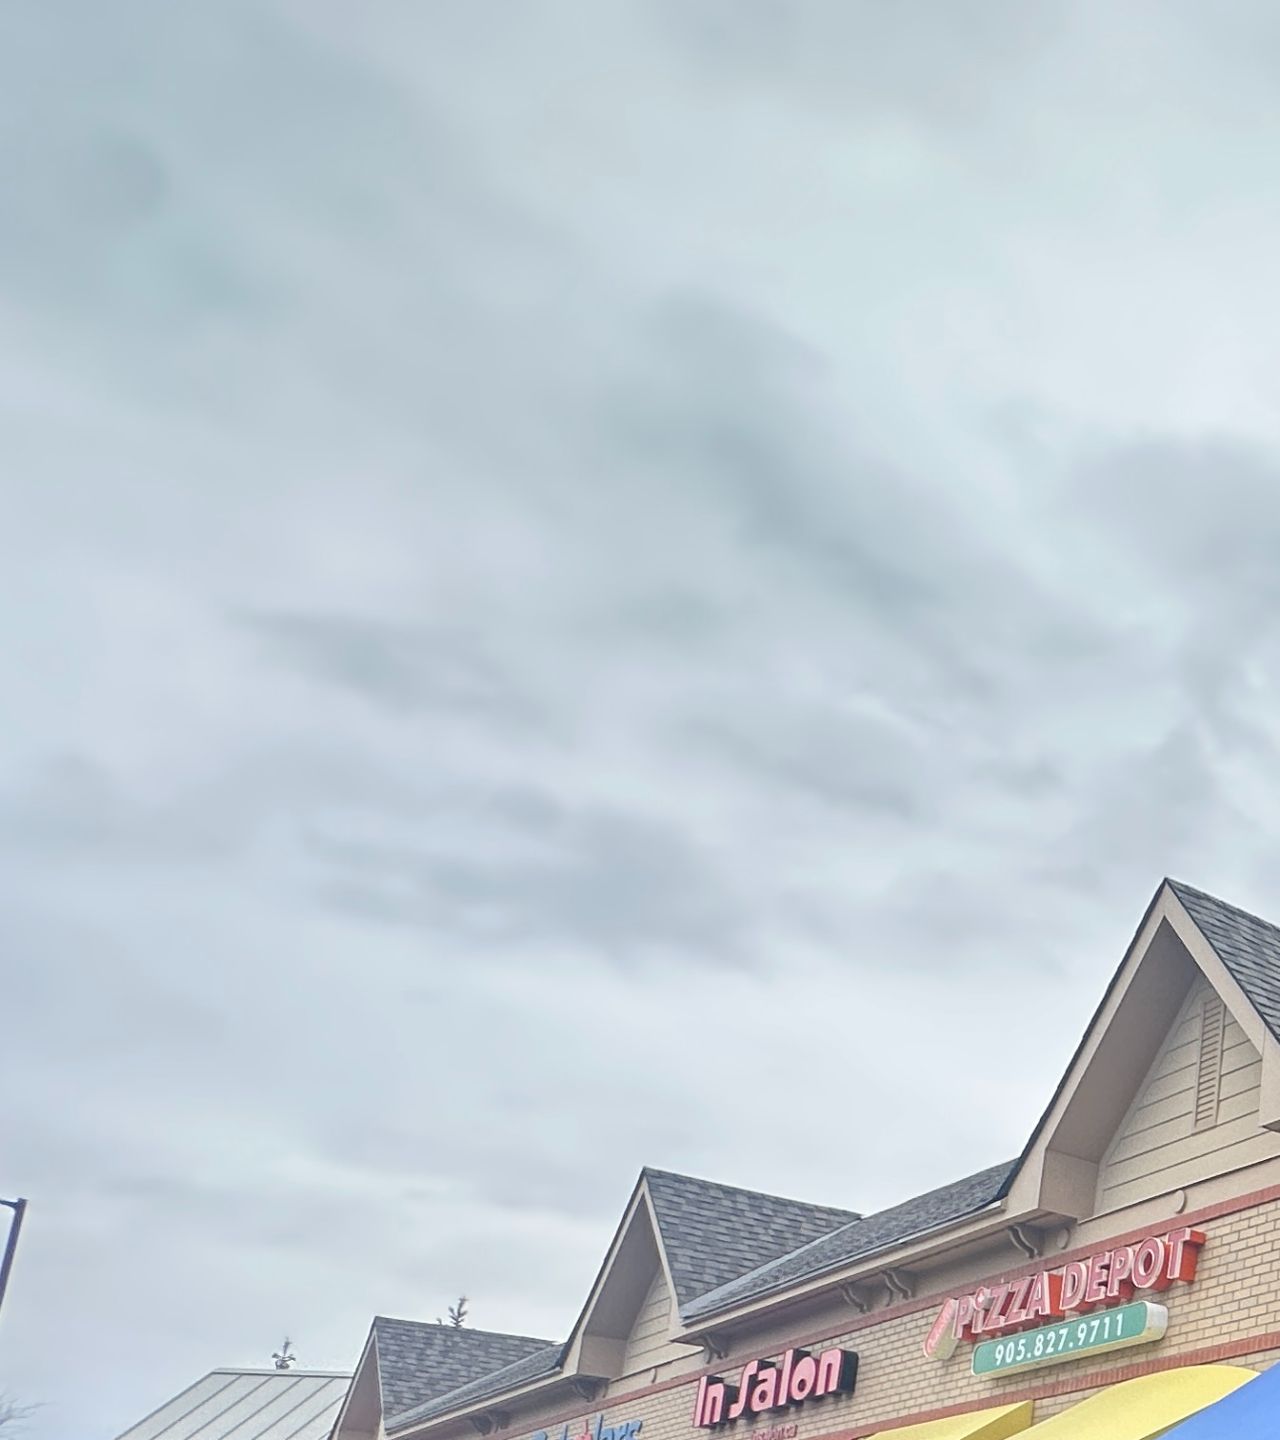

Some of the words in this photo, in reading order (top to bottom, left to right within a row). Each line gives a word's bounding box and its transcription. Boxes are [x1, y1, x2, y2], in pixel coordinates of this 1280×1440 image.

[1059, 1227, 1206, 1313] DEPOT
[995, 1313, 1124, 1366] 905.827.9711
[693, 1374, 740, 1429] In
[728, 1348, 858, 1420] Salon
